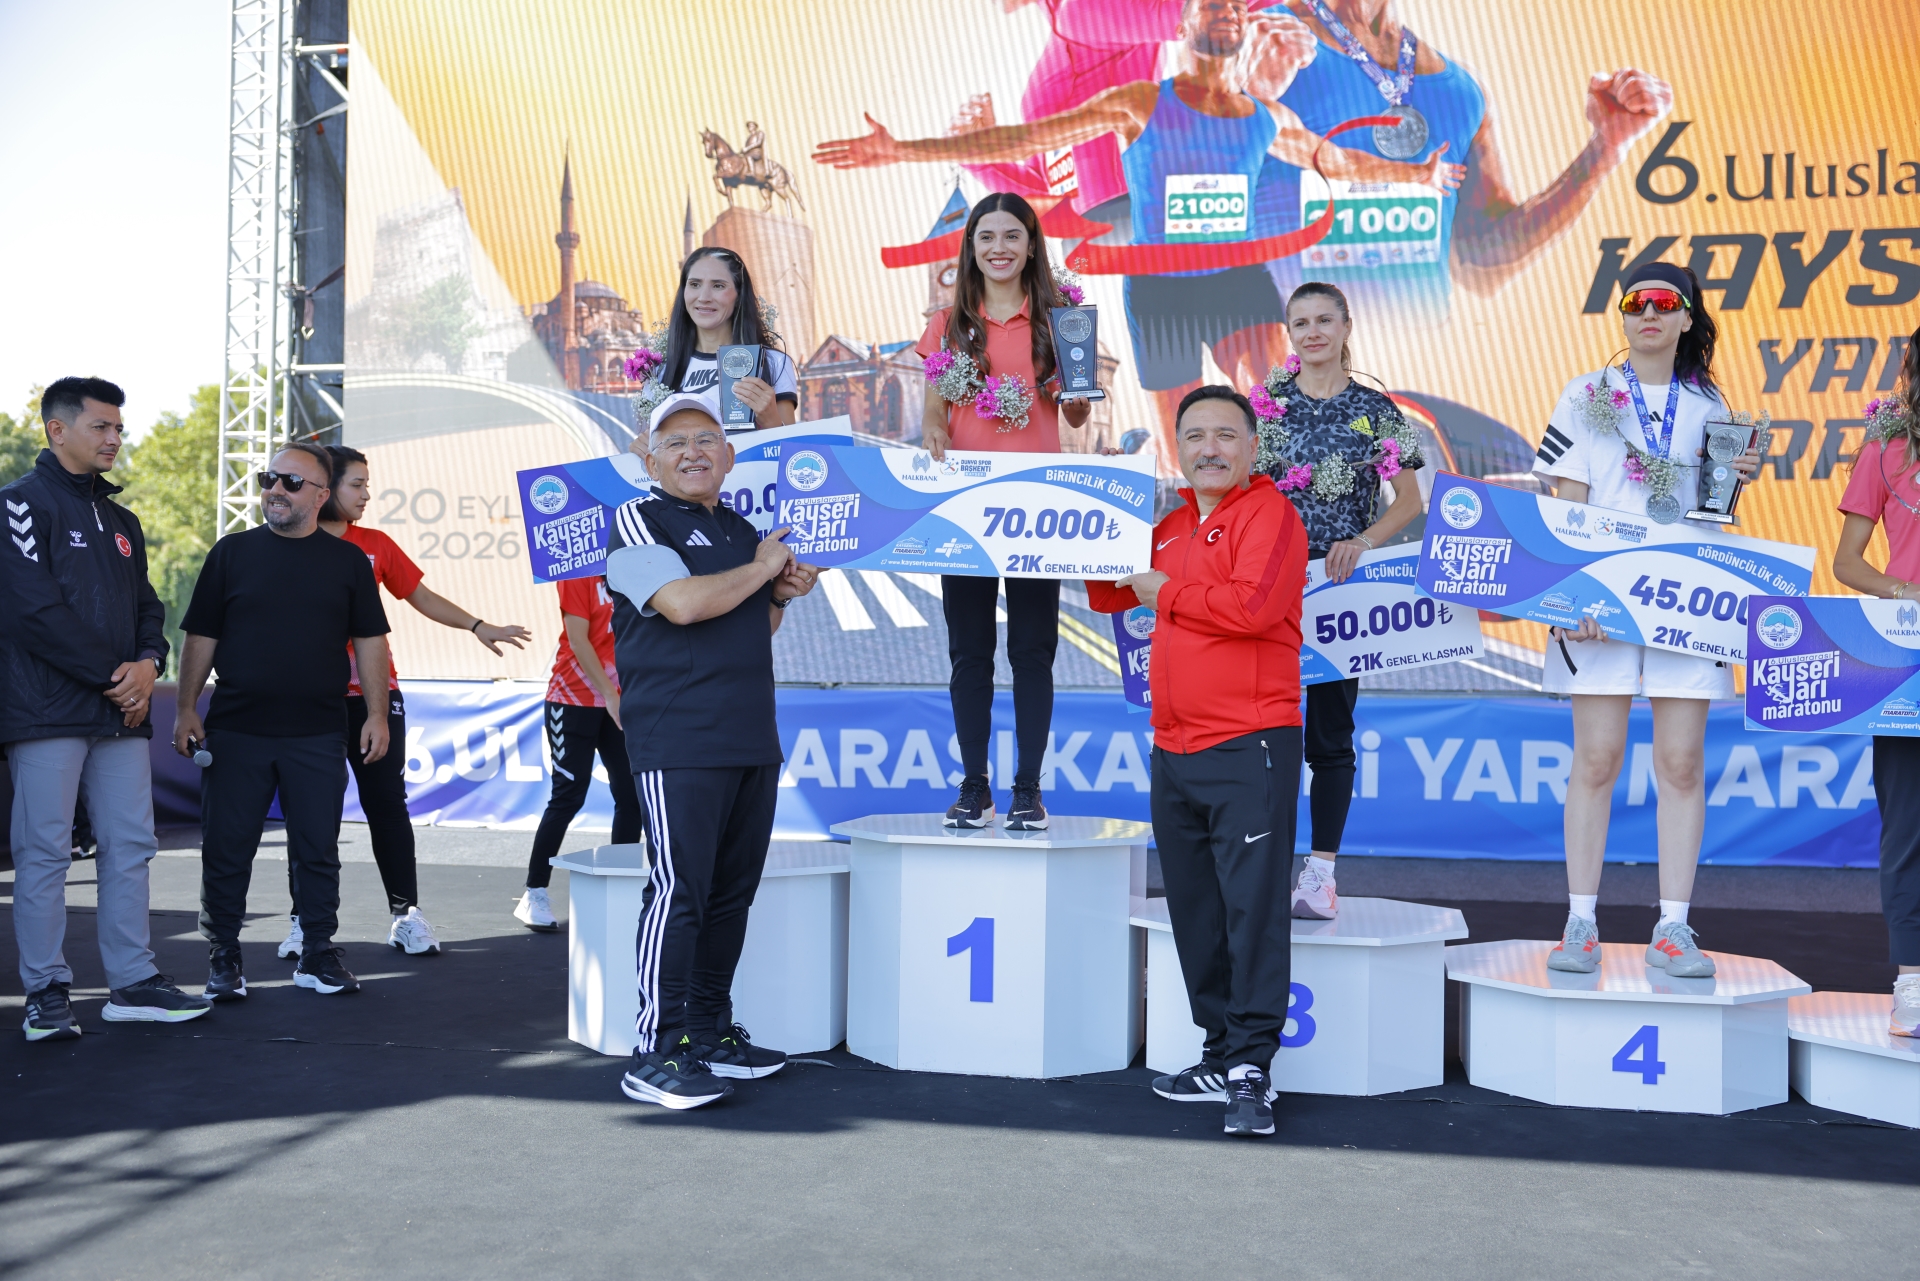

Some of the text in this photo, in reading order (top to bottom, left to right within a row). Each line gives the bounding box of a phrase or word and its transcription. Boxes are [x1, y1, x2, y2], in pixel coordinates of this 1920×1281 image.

[1168, 197, 1245, 215] 21000
[901, 474, 938, 482] HALKBANK
[378, 488, 447, 524] 20
[1107, 479, 1146, 508] ÖDÜLÜ
[779, 493, 860, 526] Kayseri
[533, 504, 605, 550] Kayseri
[1555, 527, 1591, 540] HALKBANK
[418, 532, 520, 559] 2026
[1429, 535, 1512, 564] Kayseri
[1006, 554, 1134, 575] 21K GENEL KLASMAN
[1697, 545, 1774, 583] DÖRDÜNCÜLÜK
[1433, 579, 1508, 597] maratonu
[1652, 626, 1690, 650] 21K
[1691, 641, 1728, 657] GENEL
[1349, 645, 1474, 674] 21K GENEL KLASMAN
[1753, 650, 1840, 687] Kayseri
[1762, 699, 1842, 720] maratonu
[946, 917, 995, 1003] 1
[1612, 1025, 1666, 1085] 4
